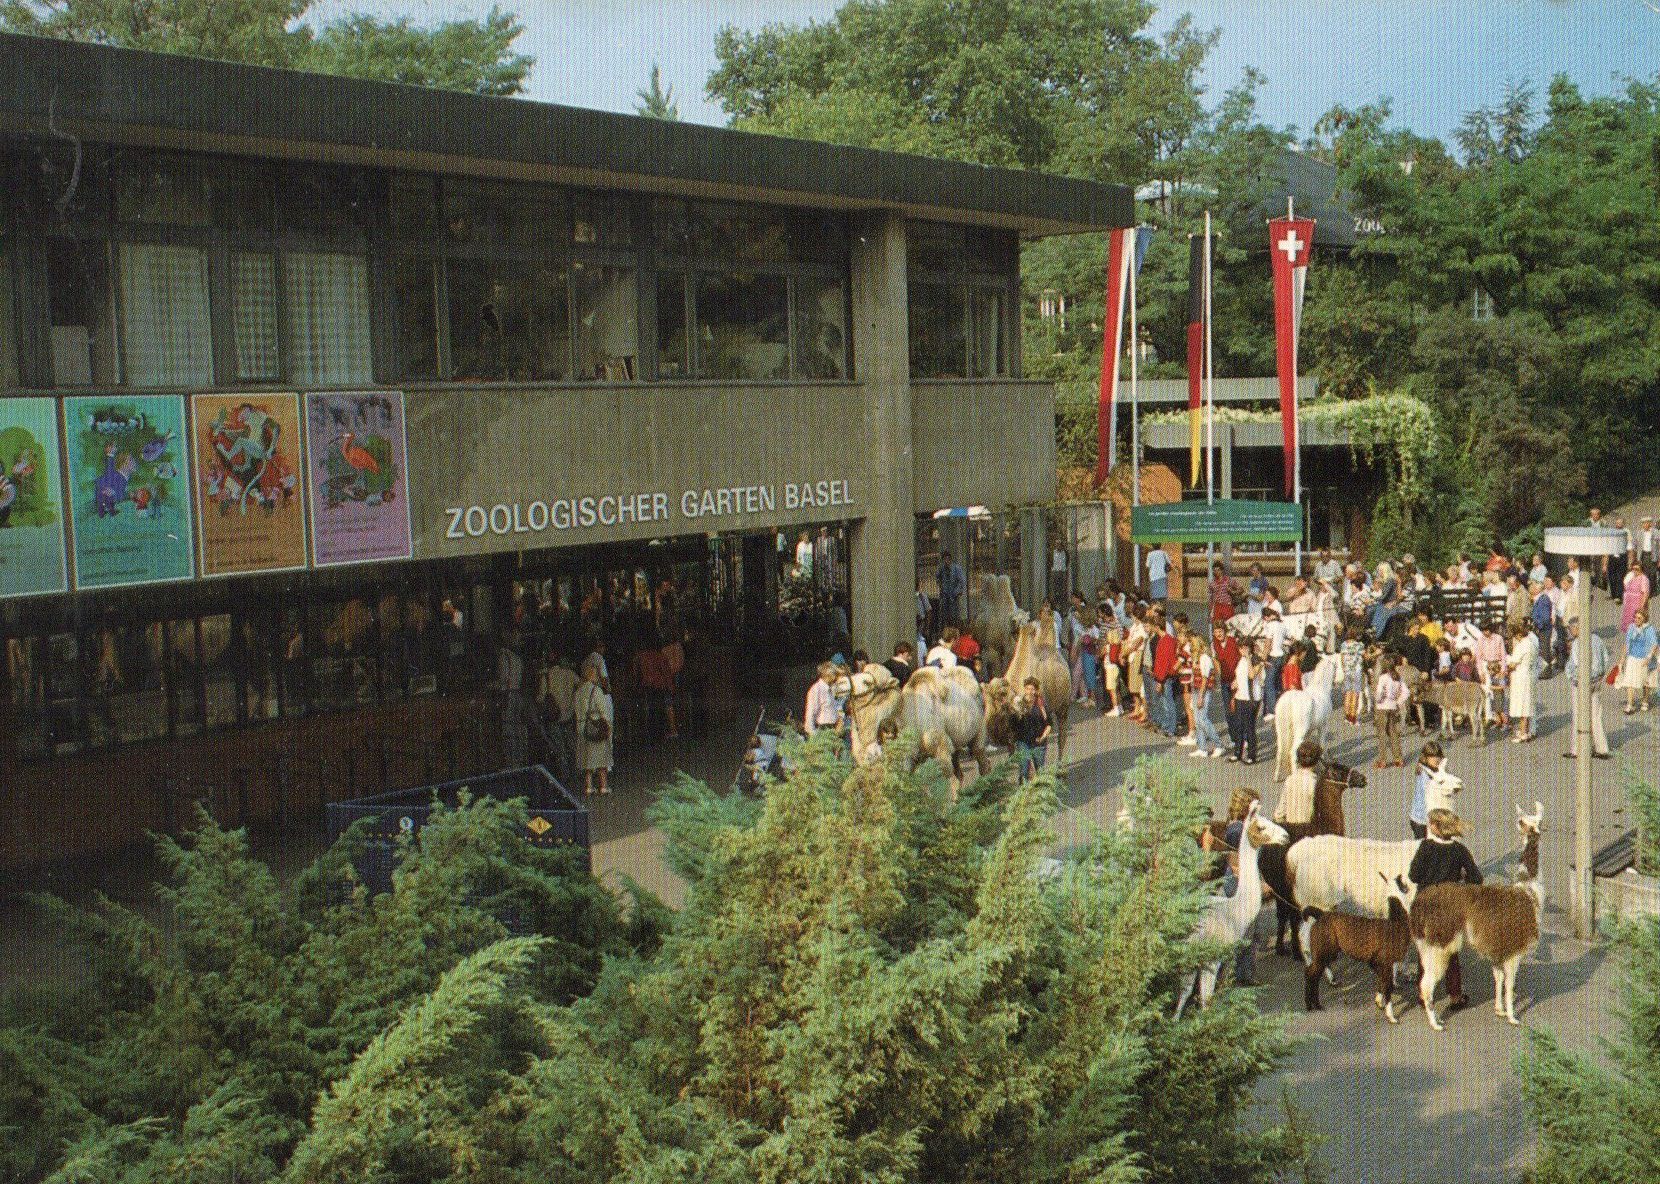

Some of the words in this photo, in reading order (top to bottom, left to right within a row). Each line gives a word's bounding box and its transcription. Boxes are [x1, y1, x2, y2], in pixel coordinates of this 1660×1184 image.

[1353, 217, 1386, 234] ZOO
[446, 493, 669, 538] ZOOLOGISCHER
[681, 485, 775, 518] GARTEN
[785, 479, 854, 510] BASEL
